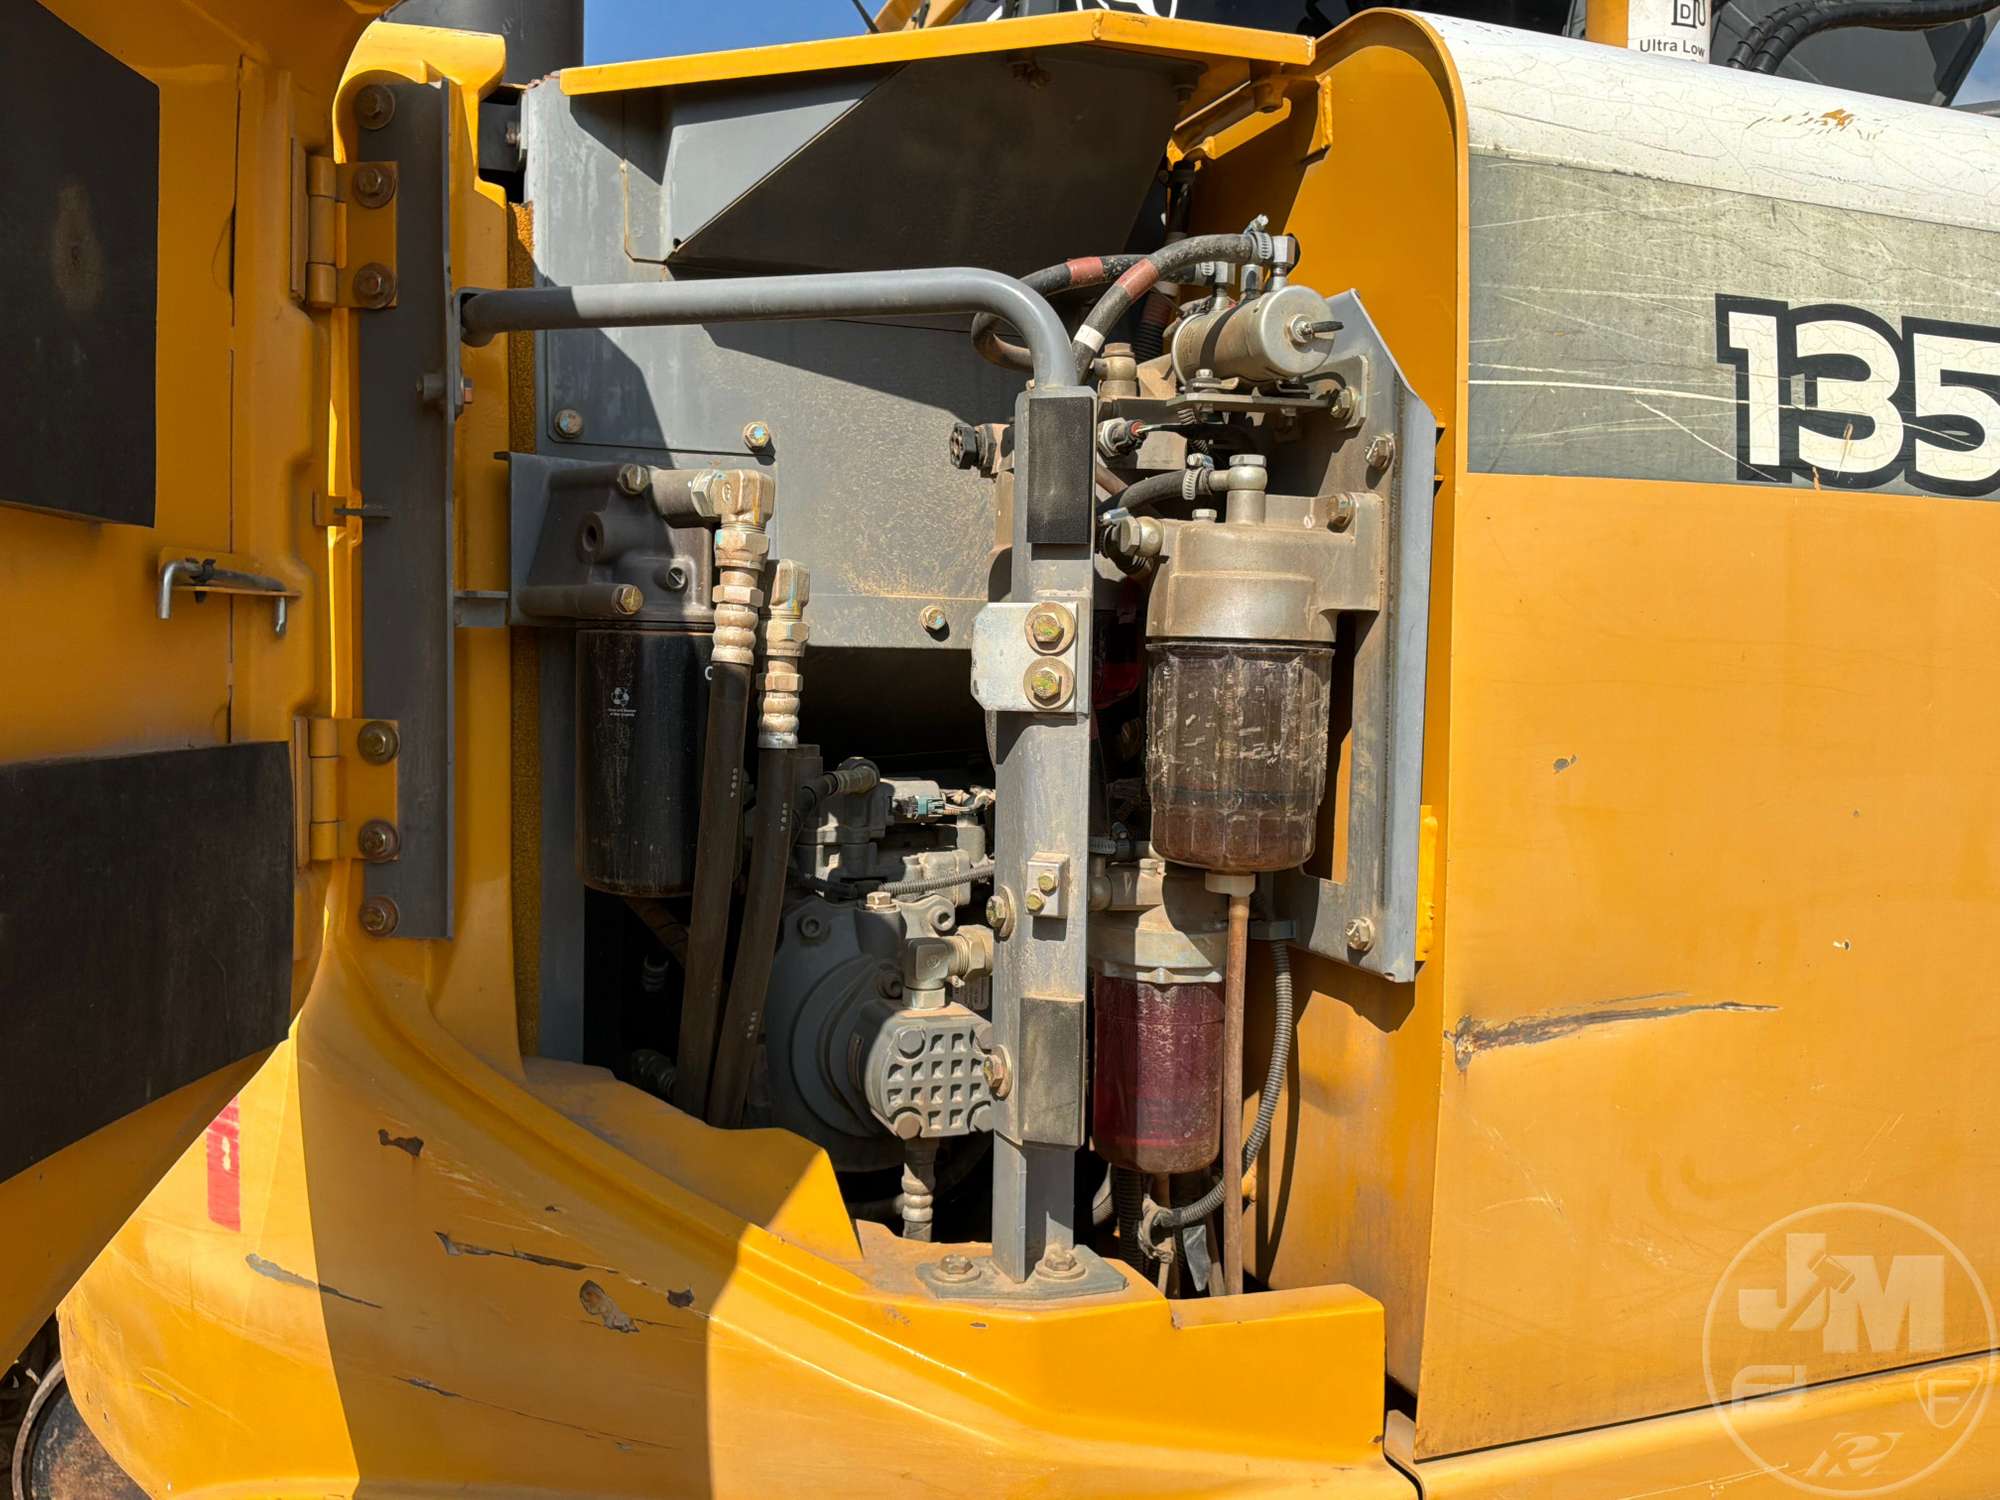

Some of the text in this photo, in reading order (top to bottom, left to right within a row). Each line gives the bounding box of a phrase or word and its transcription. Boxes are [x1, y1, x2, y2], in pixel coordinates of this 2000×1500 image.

[1639, 39, 1706, 57] Ultra Low
[1715, 293, 2000, 496] 135
